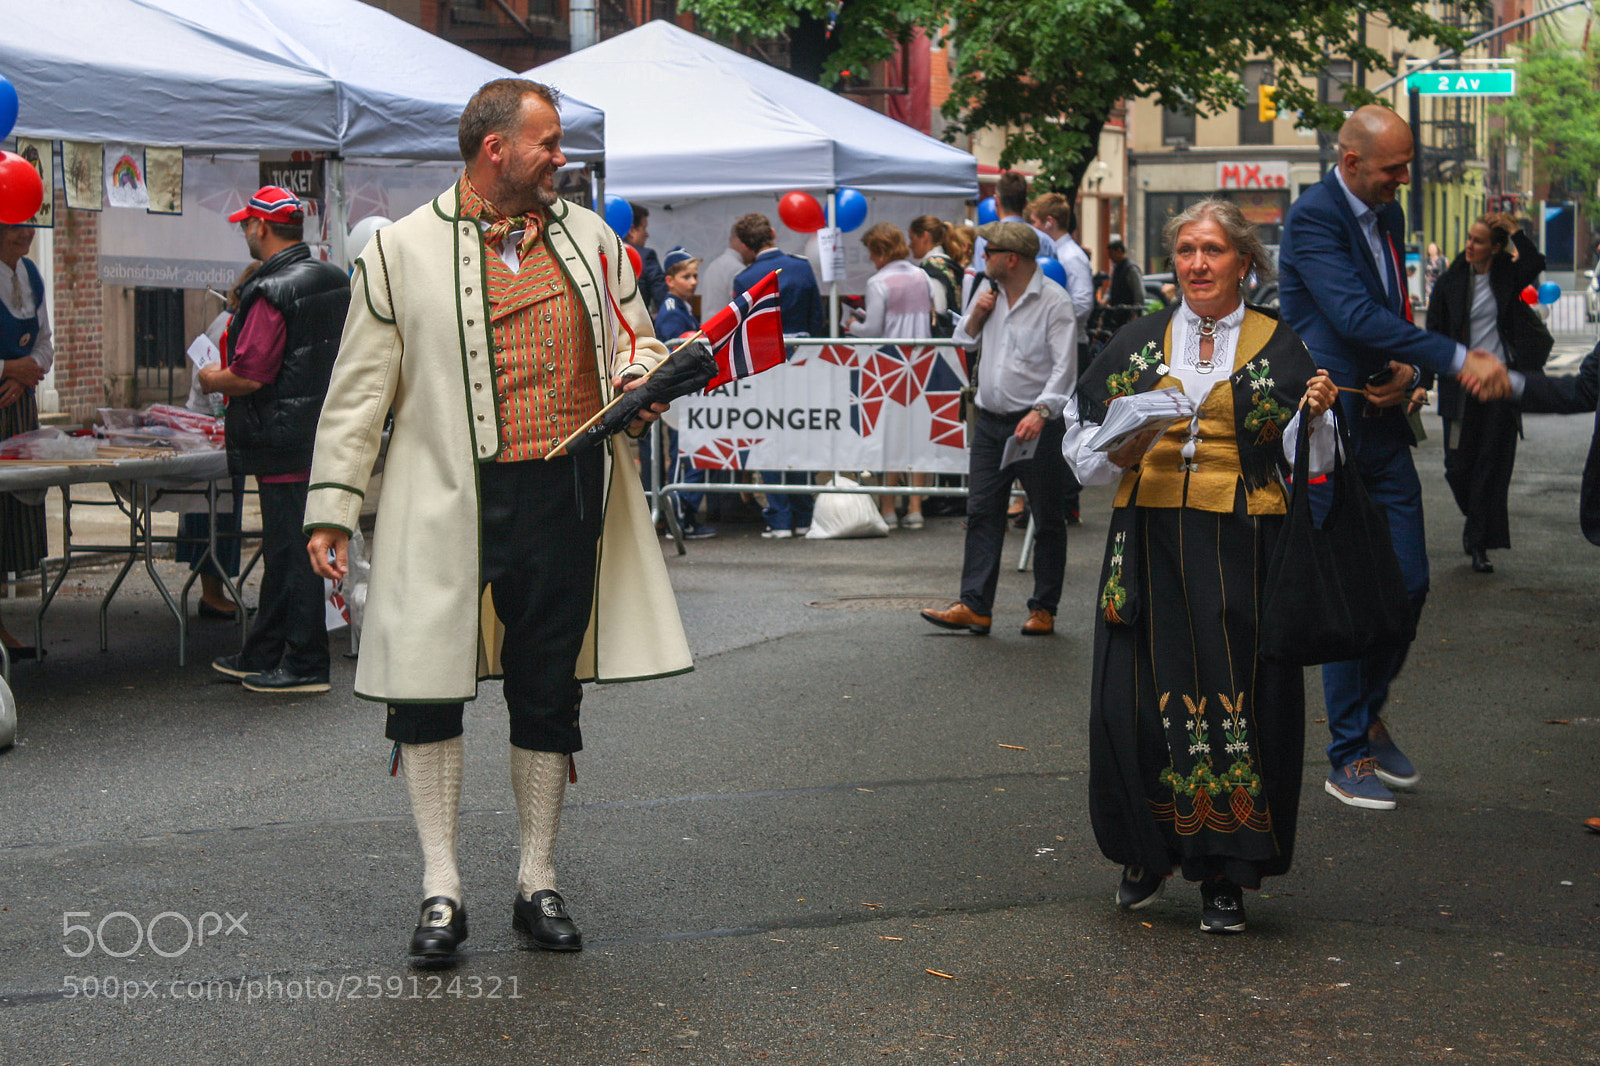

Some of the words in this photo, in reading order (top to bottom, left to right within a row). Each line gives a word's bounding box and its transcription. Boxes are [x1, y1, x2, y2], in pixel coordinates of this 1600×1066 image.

[1438, 76, 1449, 91] 2
[1455, 76, 1480, 90] Av
[272, 169, 313, 192] TICKET
[1221, 164, 1285, 187] MXco
[687, 407, 841, 431] KUPONGER
